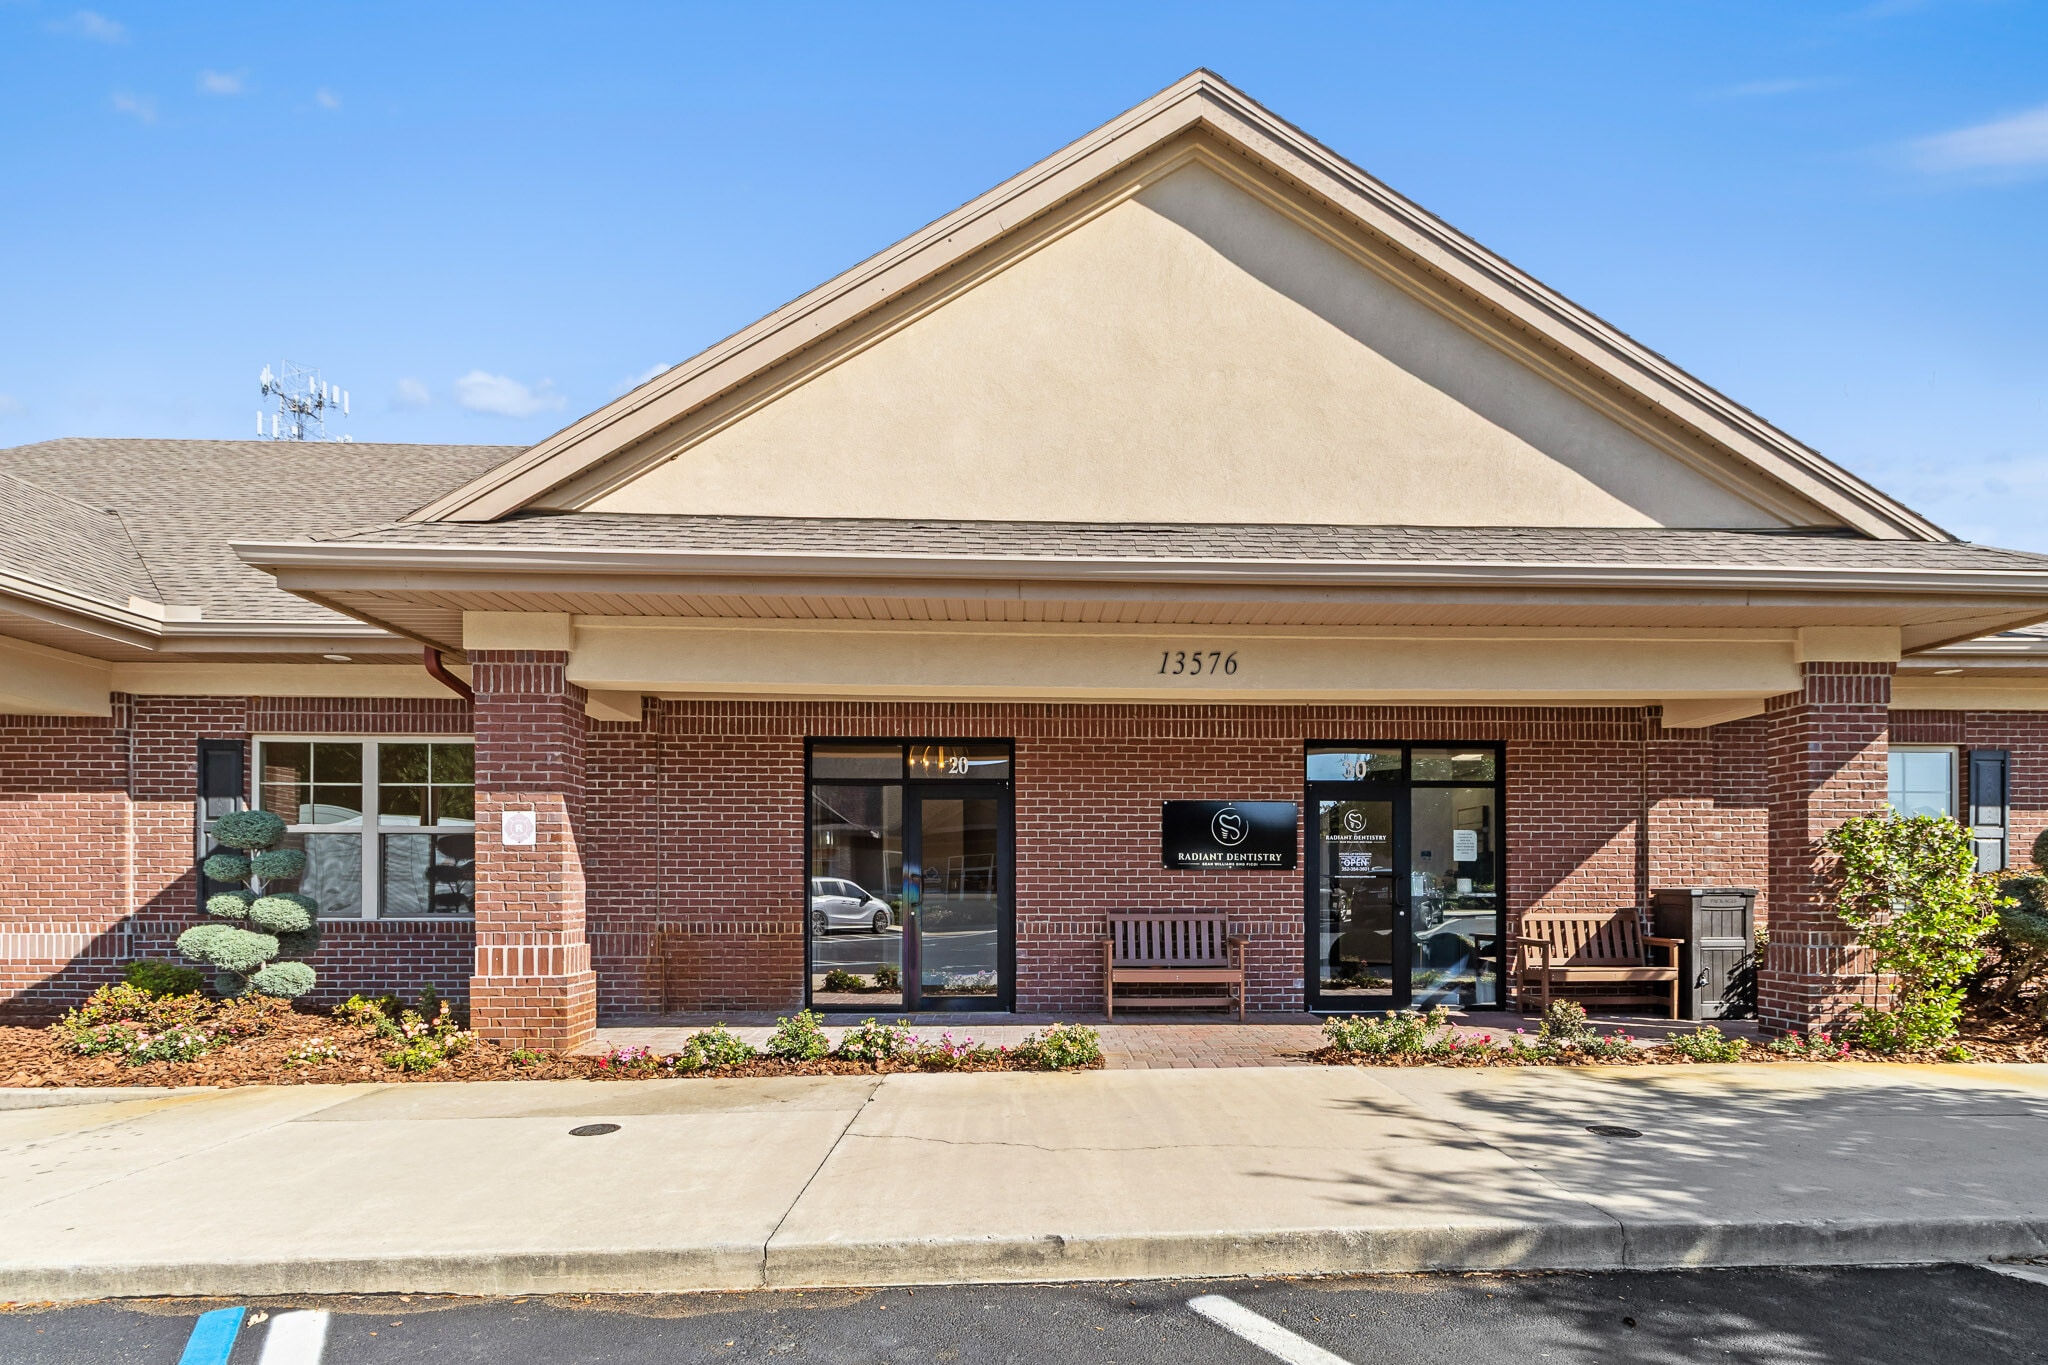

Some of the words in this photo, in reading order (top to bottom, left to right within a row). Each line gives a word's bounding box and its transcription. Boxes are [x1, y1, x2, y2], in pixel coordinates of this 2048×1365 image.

[1157, 650, 1239, 675] 13576
[948, 756, 969, 774] 20
[1342, 760, 1367, 778] 30
[515, 823, 524, 833] R
[1178, 852, 1224, 861] RADIANT
[1226, 853, 1283, 862] DENTISTRY
[1343, 859, 1368, 867] OPEN
